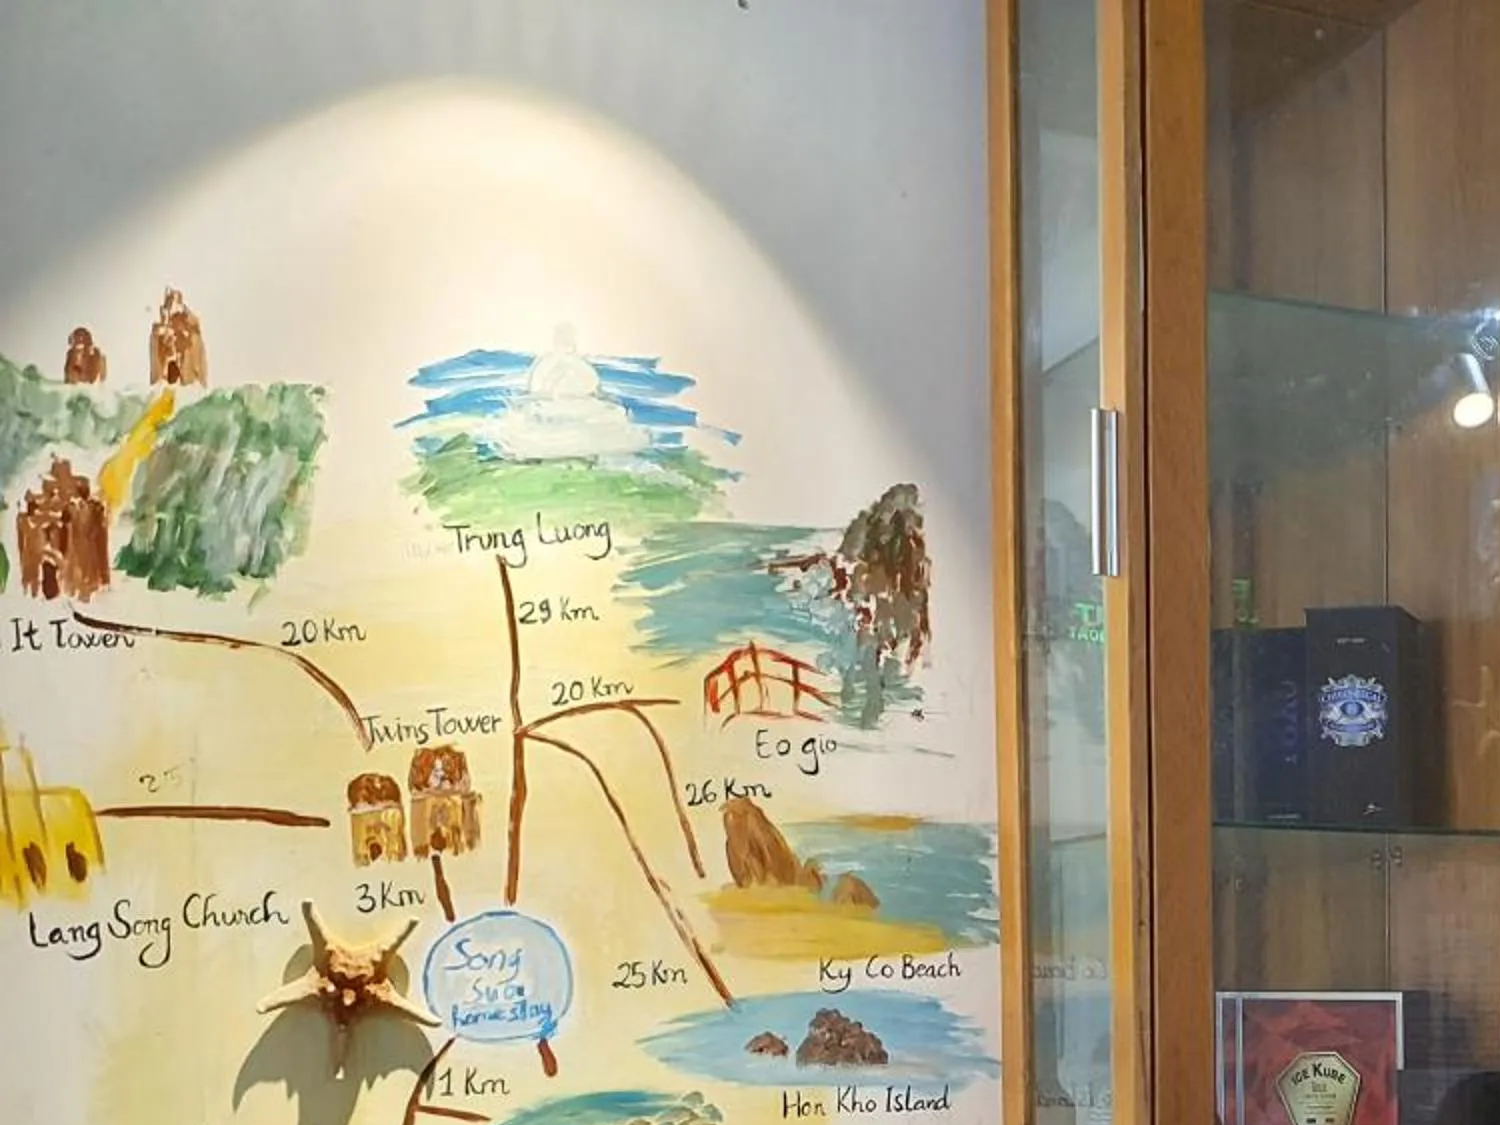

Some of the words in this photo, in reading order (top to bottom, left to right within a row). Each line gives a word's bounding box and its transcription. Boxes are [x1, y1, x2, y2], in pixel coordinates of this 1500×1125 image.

[442, 524, 528, 569] Trung
[426, 707, 502, 738] Tower
[28, 911, 102, 961] Lang
[107, 899, 172, 969] Song
[183, 890, 290, 929] Church
[901, 952, 962, 980] Beach
[836, 1083, 878, 1114] Kho
[885, 1083, 951, 1114] Island
